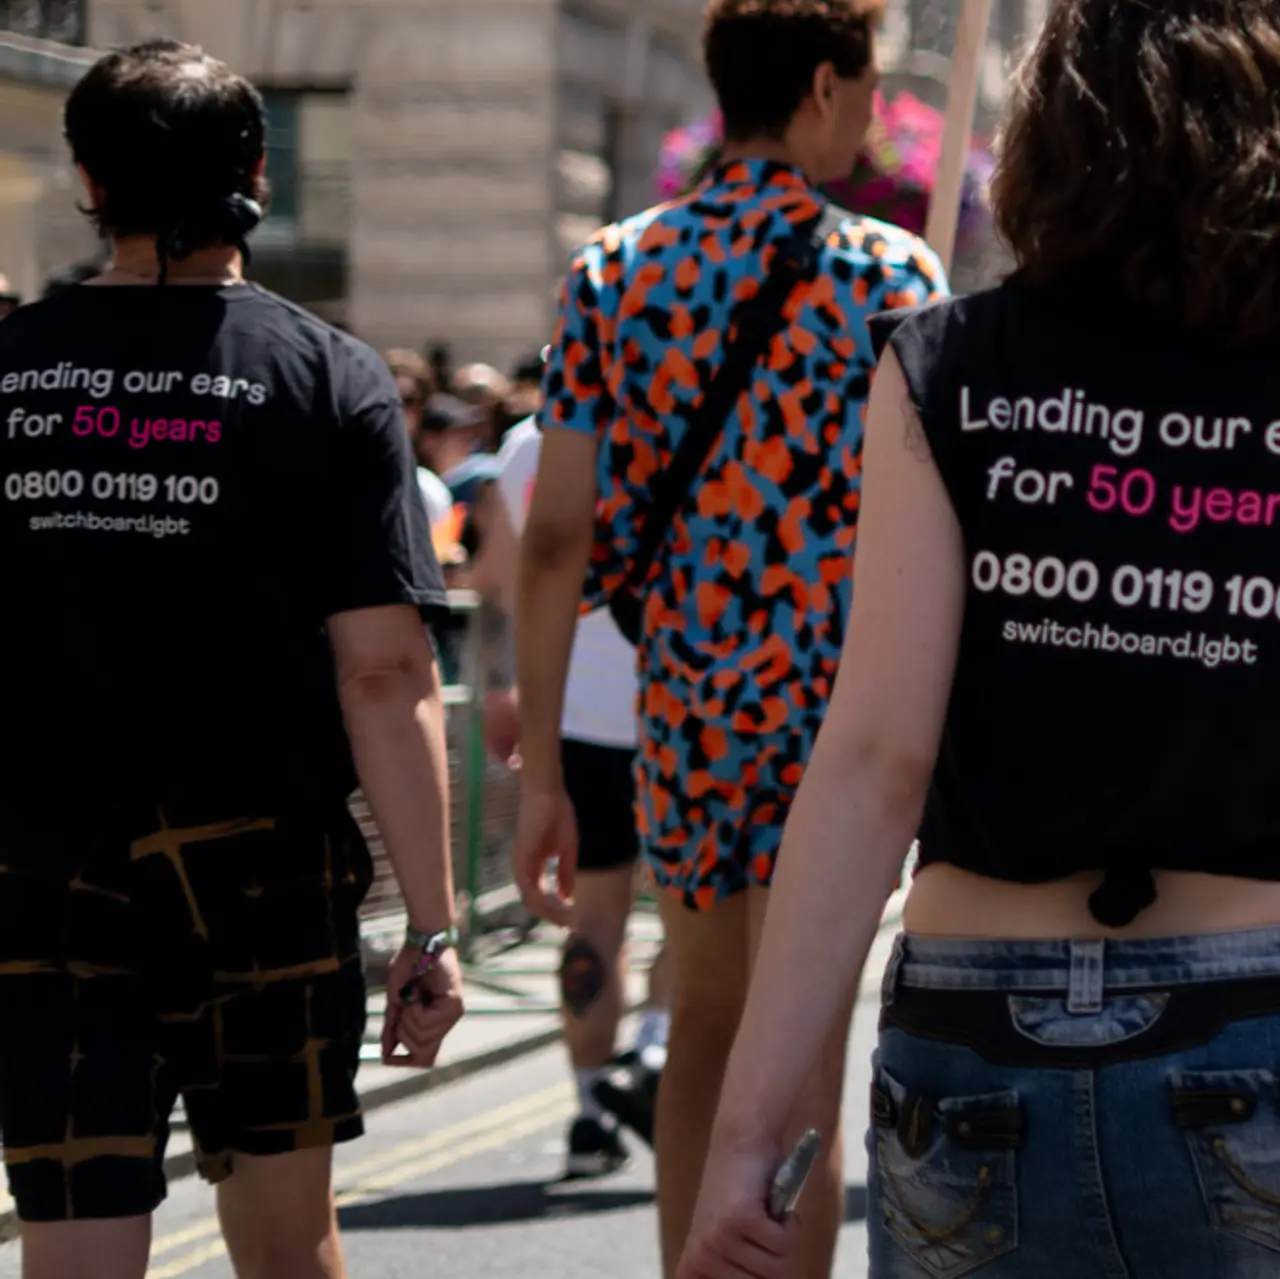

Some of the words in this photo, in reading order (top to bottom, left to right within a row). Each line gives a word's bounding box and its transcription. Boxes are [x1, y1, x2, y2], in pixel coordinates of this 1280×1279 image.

[0, 361, 114, 398] ending
[123, 370, 184, 394] our
[190, 372, 267, 405] ears
[7, 407, 63, 439] for
[71, 405, 121, 438] 50
[128, 417, 223, 449] years
[960, 386, 1144, 456] Lending
[1158, 411, 1253, 450] our
[4, 469, 84, 501] 0800
[91, 470, 158, 502] 0119
[164, 475, 220, 505] 100
[985, 456, 1074, 504] for
[1086, 464, 1157, 516] 50
[971, 550, 1099, 602] 0800
[1111, 564, 1213, 613] 0119
[1002, 618, 1258, 668] switchboard.lgbt
